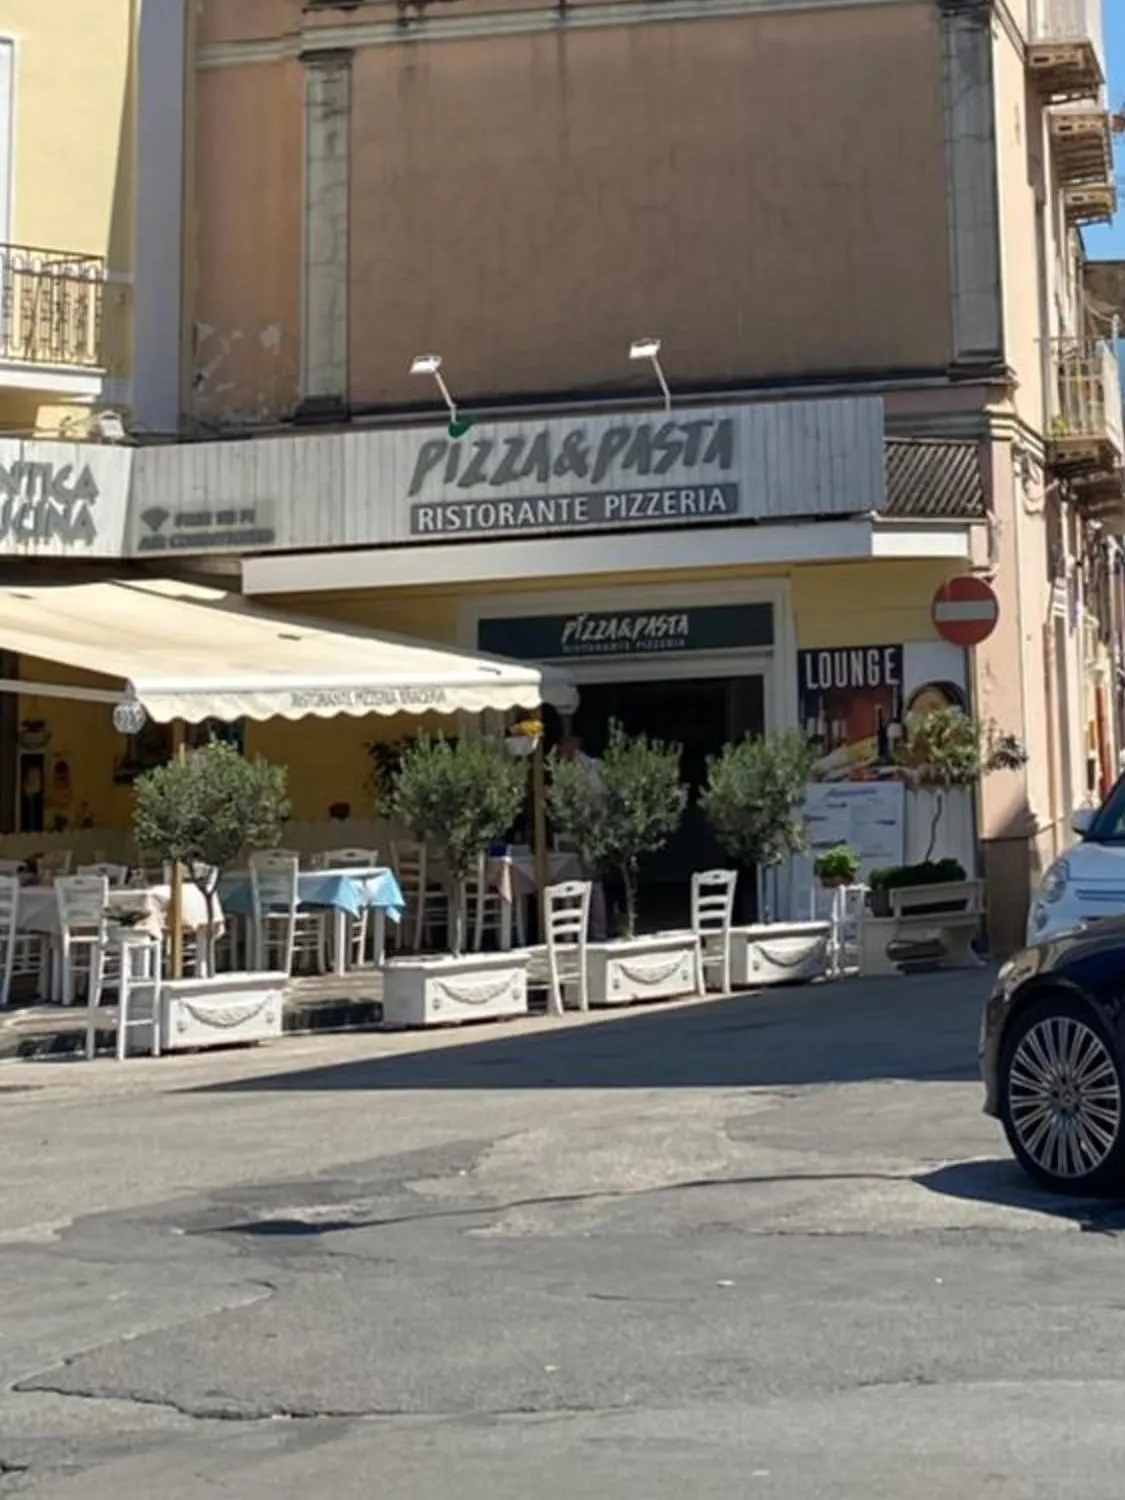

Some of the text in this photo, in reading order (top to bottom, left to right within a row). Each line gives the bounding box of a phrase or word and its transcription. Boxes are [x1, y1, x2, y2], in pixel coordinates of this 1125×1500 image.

[408, 418, 733, 497] PIZZA&PASTA
[417, 488, 727, 531] RISTORANTE PIZZERIA
[561, 613, 688, 644] PIZZA&PASTA
[805, 648, 899, 689] LOUNGE
